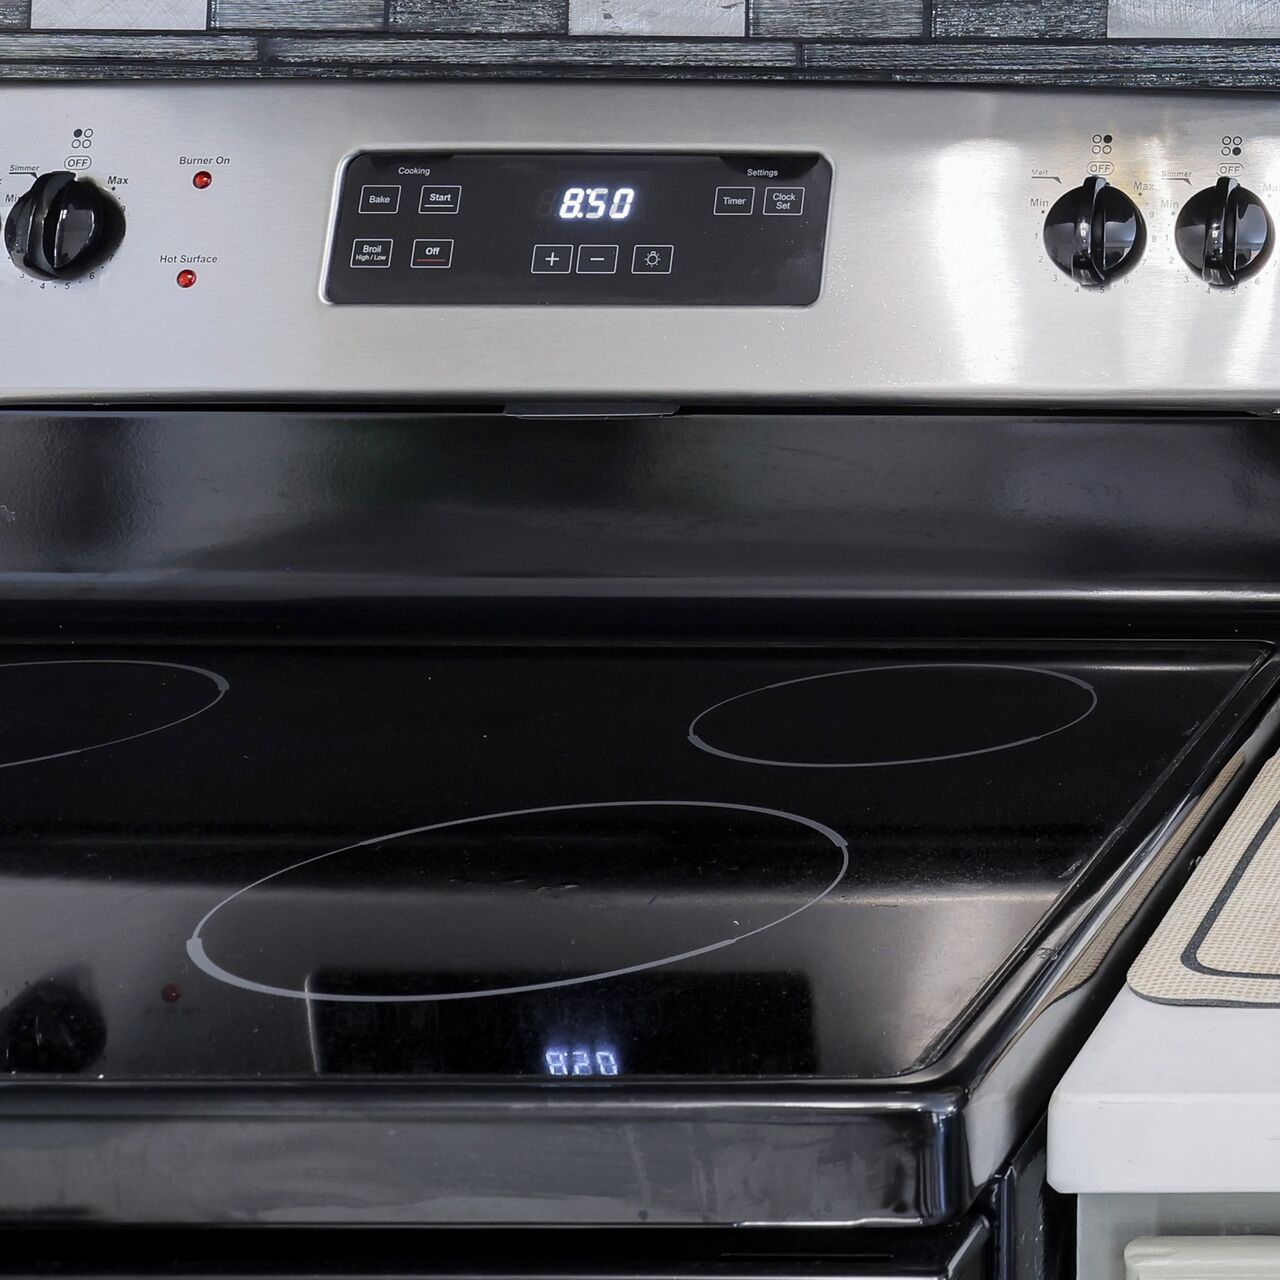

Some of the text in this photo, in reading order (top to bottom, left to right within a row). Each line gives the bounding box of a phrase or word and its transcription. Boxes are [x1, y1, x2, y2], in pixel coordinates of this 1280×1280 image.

[67, 158, 89, 168] OFF
[179, 156, 231, 165] Burner On
[9, 164, 40, 172] Simmer
[398, 167, 431, 176] Cooking
[1089, 164, 1110, 173] OFF
[1219, 166, 1240, 174] OFF
[747, 168, 778, 177] Settings
[107, 175, 129, 185] Max
[1133, 182, 1154, 191] Max
[369, 195, 391, 203] Bake
[429, 193, 452, 201] Start
[723, 197, 747, 205] Timer
[772, 193, 796, 201] Clock
[776, 202, 791, 210] Set
[1029, 199, 1049, 207] Min
[1160, 200, 1179, 208] Min
[362, 245, 382, 253] Broil
[425, 247, 440, 255] Off
[159, 254, 218, 263] Hot Surface
[89, 271, 96, 280] 6
[39, 282, 46, 290] 4
[64, 282, 71, 290] 5
